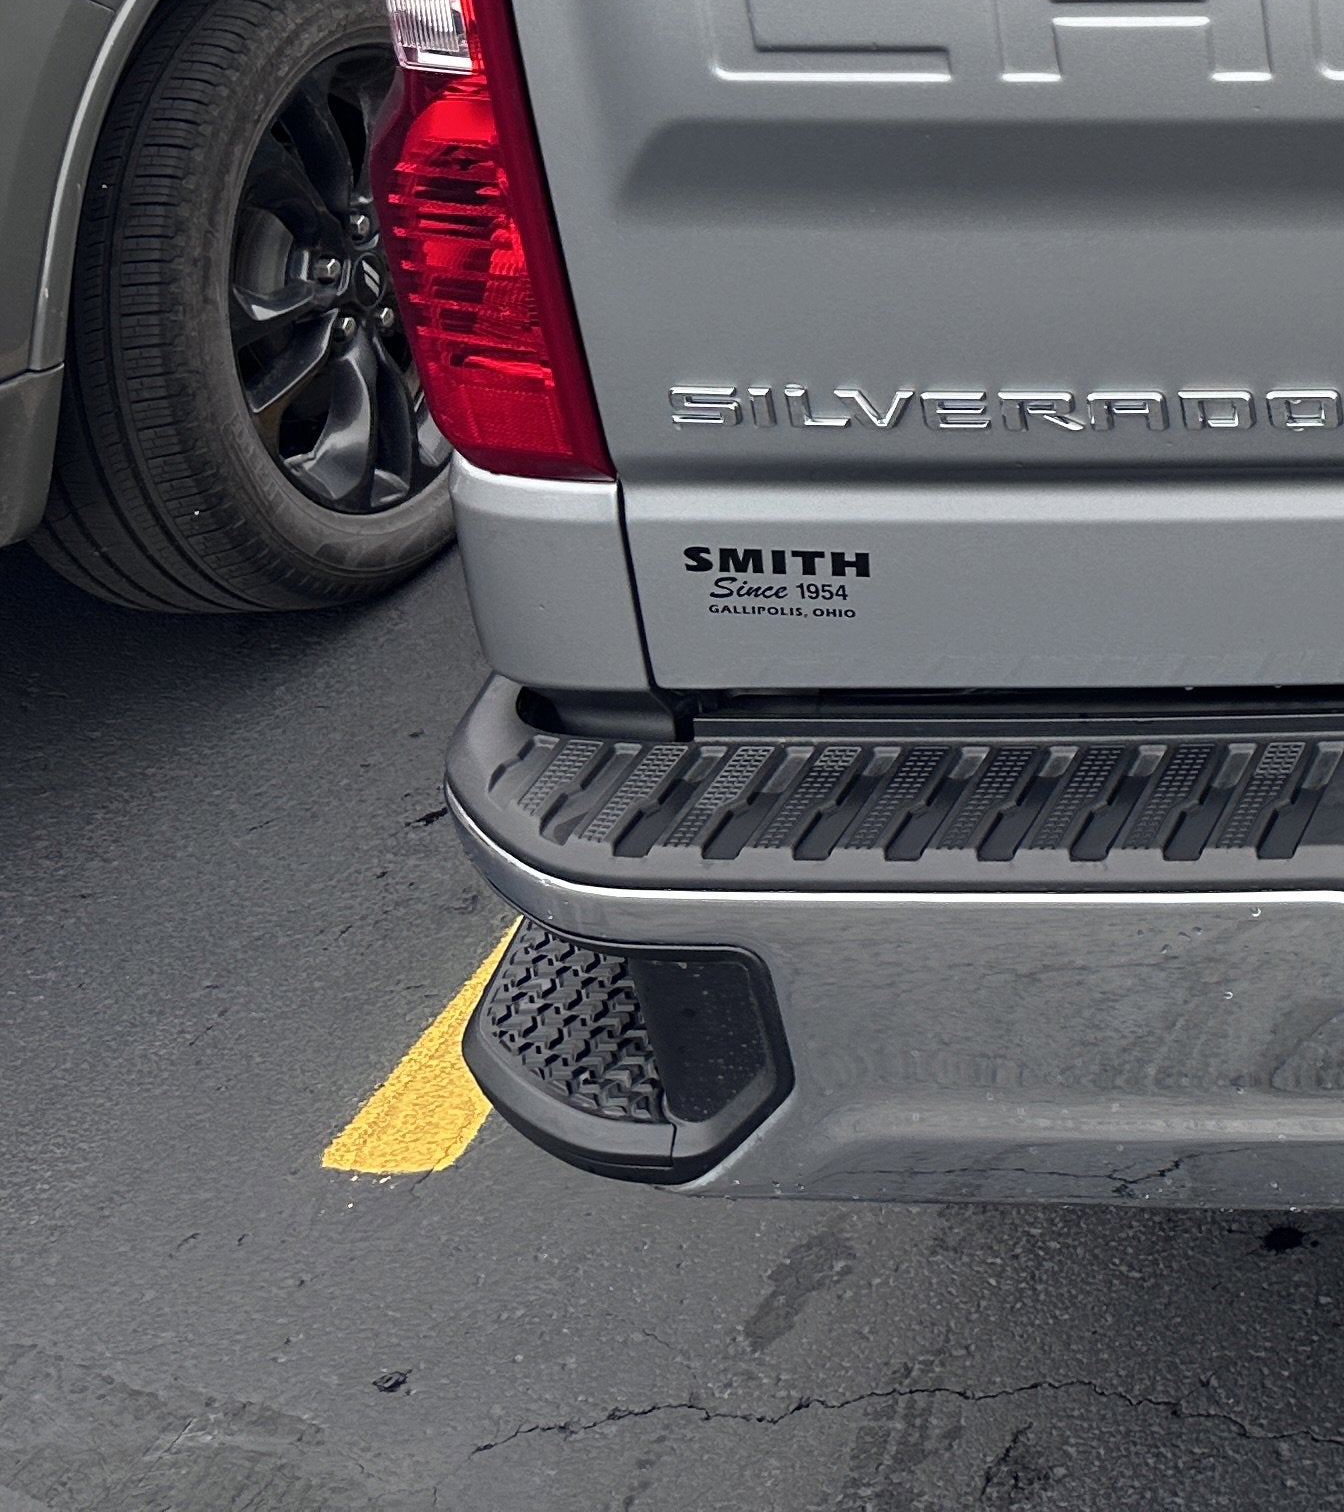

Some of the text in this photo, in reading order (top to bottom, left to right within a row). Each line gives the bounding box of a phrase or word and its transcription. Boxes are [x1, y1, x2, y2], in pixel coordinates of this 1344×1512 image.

[668, 384, 1344, 431] SILVERADO
[683, 546, 871, 578] SMITH
[709, 576, 848, 601] Since 1954
[708, 604, 856, 618] GALLIPOLIS, OHIO
